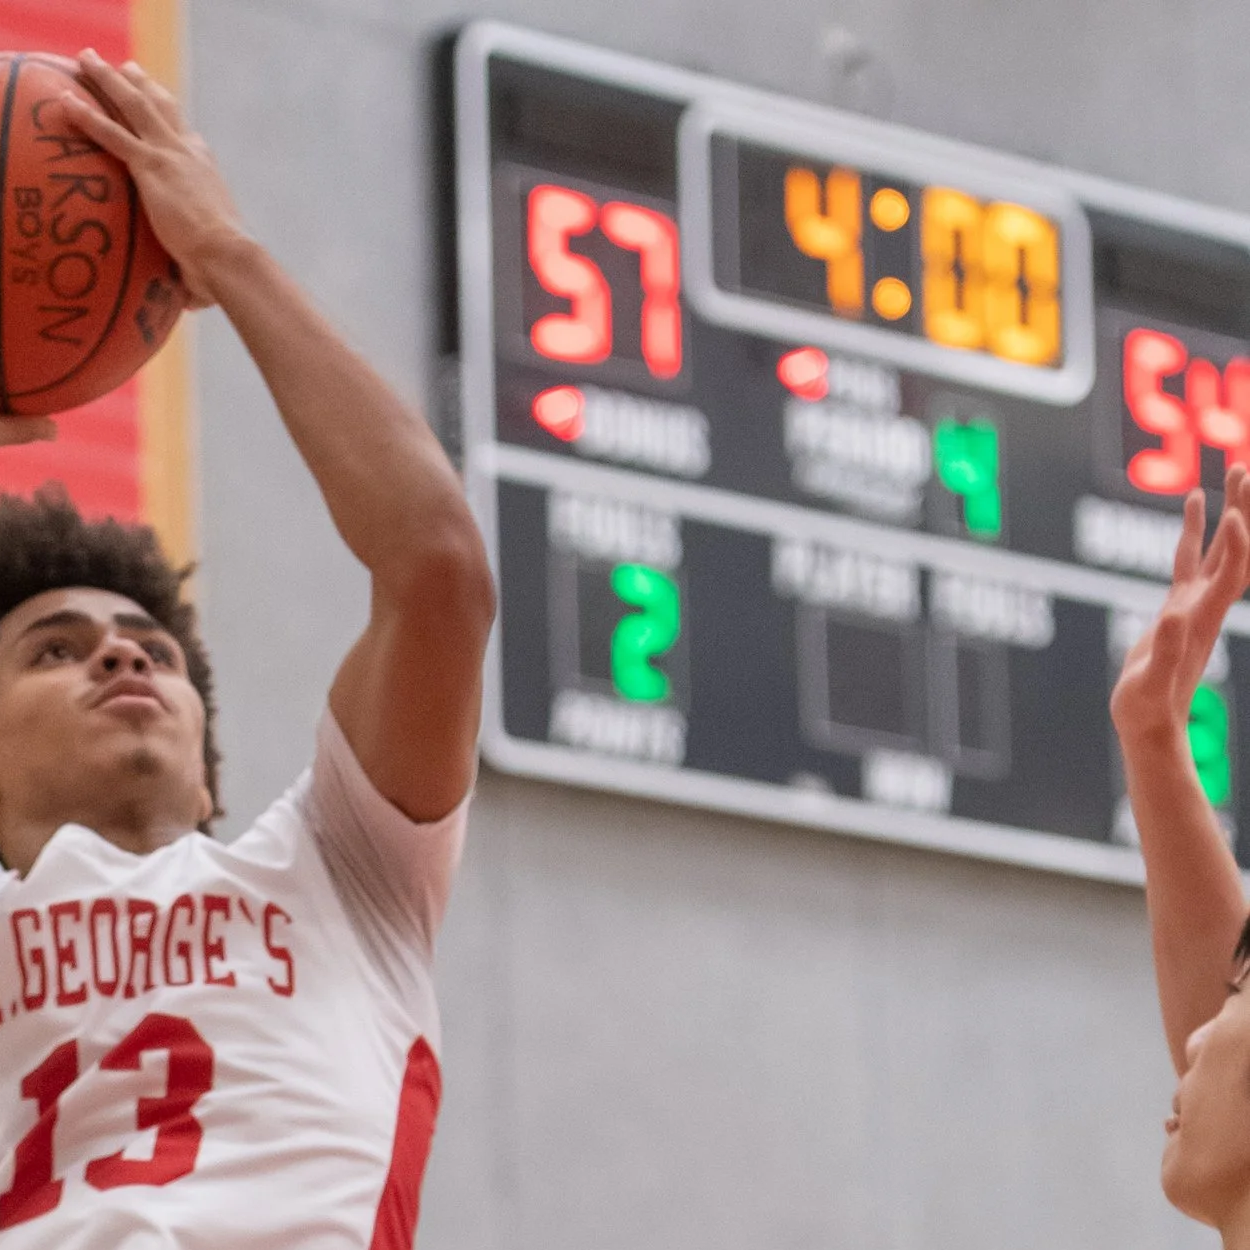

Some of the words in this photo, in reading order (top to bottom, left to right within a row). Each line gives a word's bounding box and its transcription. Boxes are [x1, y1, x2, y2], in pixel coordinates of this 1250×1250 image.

[12, 186, 44, 286] BOYS
[30, 98, 111, 346] CARSON
[526, 183, 683, 381] 57
[783, 165, 1061, 368] 4:00
[935, 418, 1000, 537] 4
[1123, 327, 1250, 496] 54
[611, 562, 680, 703] 2
